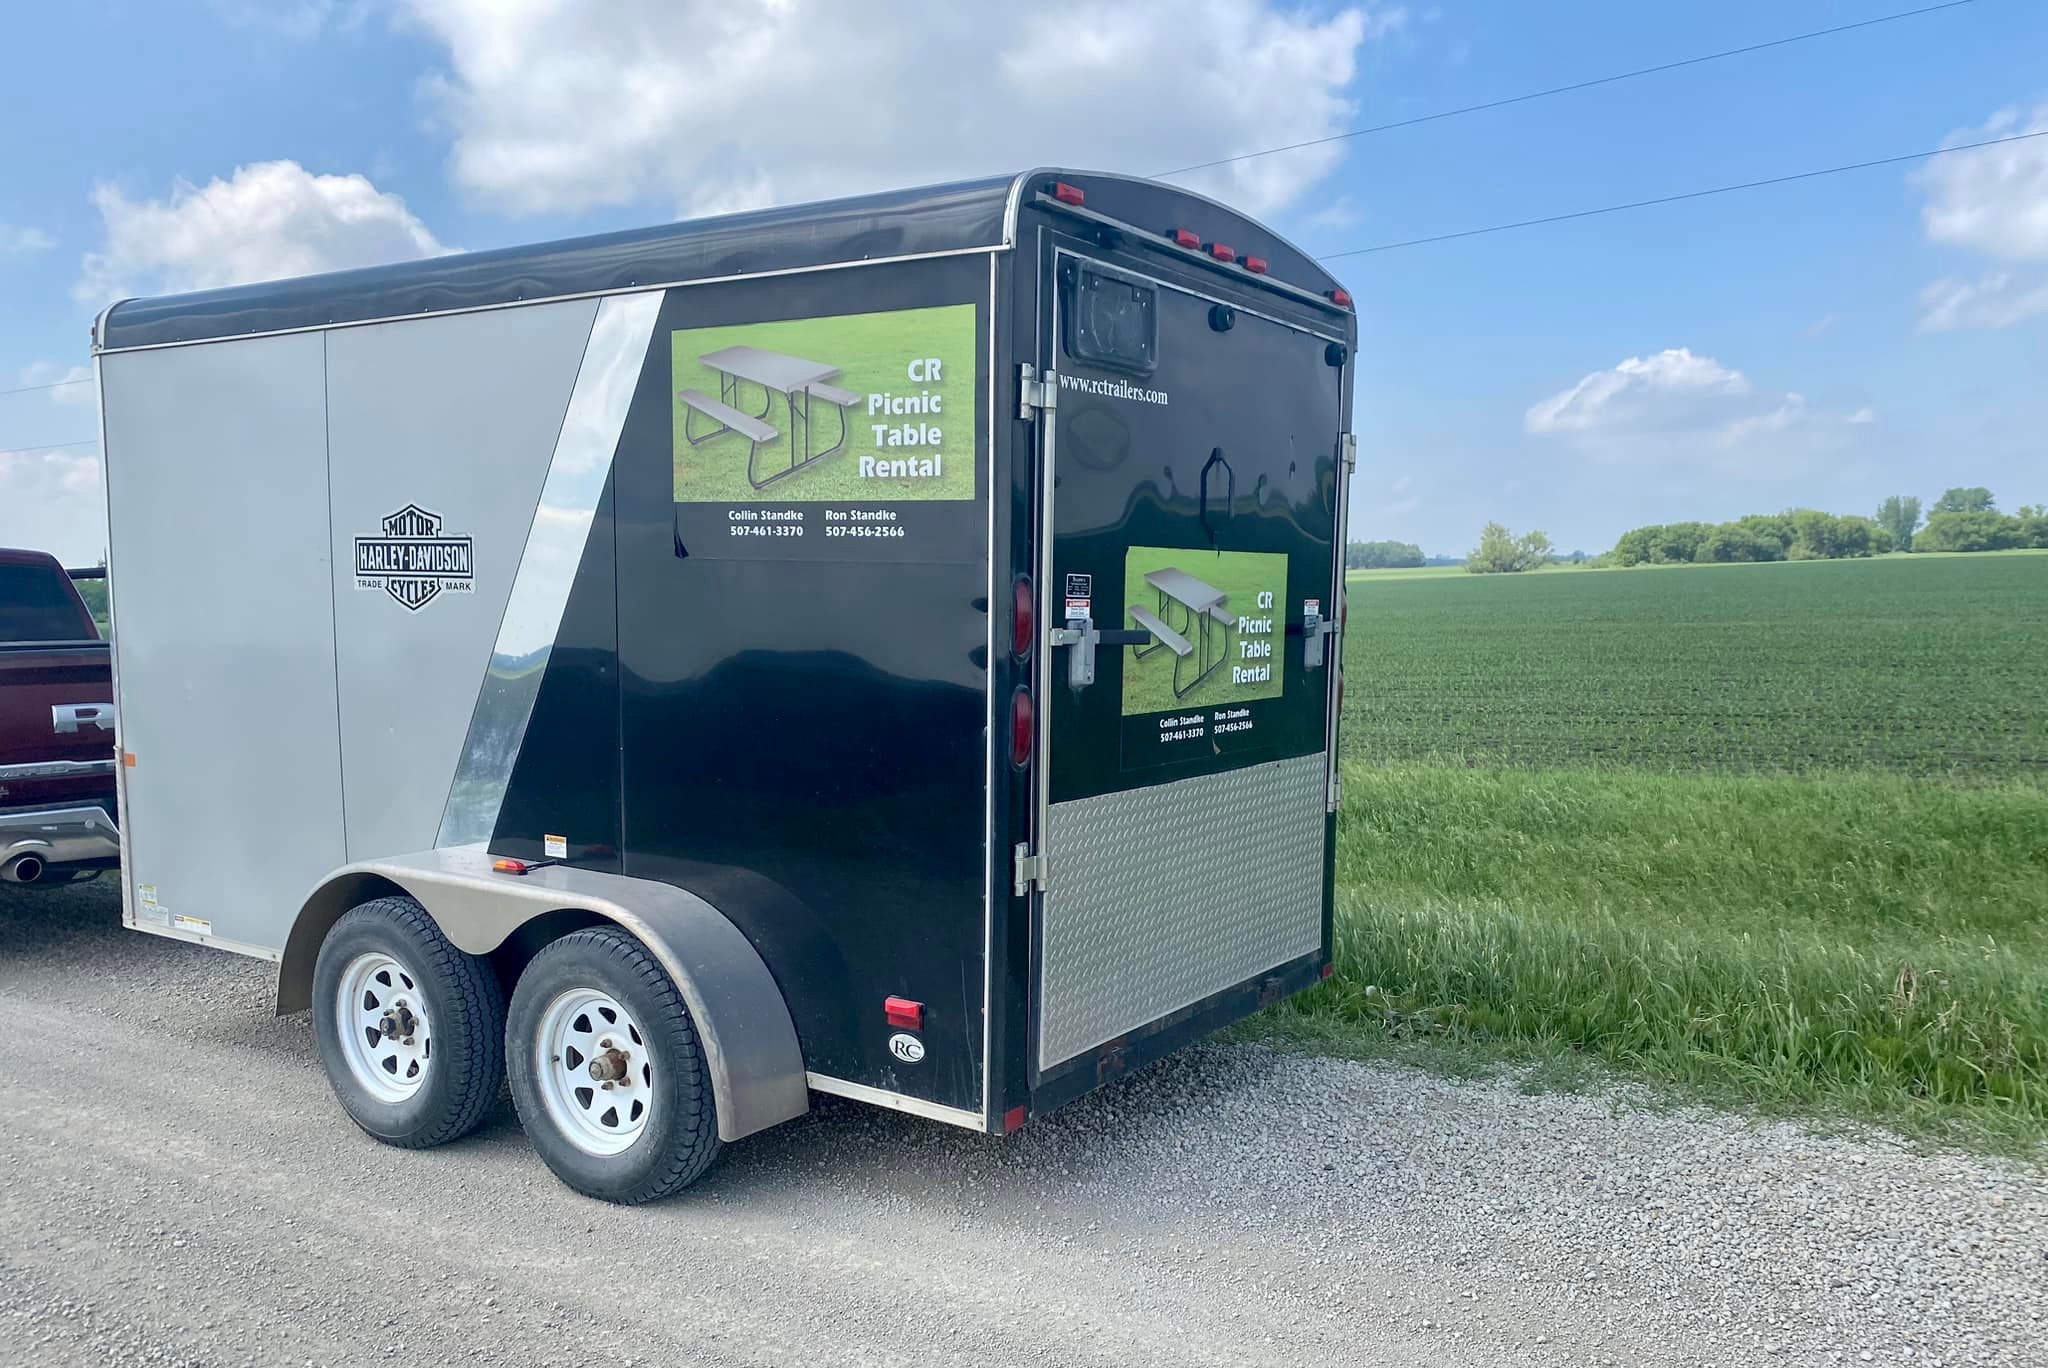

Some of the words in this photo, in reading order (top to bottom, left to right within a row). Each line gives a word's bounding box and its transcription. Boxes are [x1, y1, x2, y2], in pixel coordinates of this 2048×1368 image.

[907, 358, 942, 382] CR
[1059, 374, 1168, 405] www.rctrailers.com
[868, 390, 942, 416] Picnic
[871, 422, 942, 447] Table
[859, 454, 942, 478] Rental
[388, 509, 435, 536] MOTOR
[728, 510, 758, 521] Collin
[760, 510, 804, 521] Standke
[825, 510, 847, 521] Ron
[850, 509, 897, 521] Standke
[730, 526, 804, 536] 507-461-3370
[825, 526, 905, 537] 507-456-2566
[359, 544, 468, 572] HARLEY-DAVIDSON
[358, 579, 383, 589] TRADE
[445, 582, 472, 591] MARK
[391, 579, 436, 605] CYCLES
[1257, 591, 1273, 609] CR
[1238, 615, 1272, 634] Picnic
[1239, 640, 1272, 659] Table
[1232, 663, 1271, 684] Rental
[1160, 717, 1179, 729] Collin
[1179, 714, 1205, 726] Standke
[1214, 711, 1227, 721] Ron
[1227, 708, 1250, 719] Standke
[1160, 727, 1204, 743] 507-461-3370
[1214, 720, 1253, 734] 507-456-2566
[894, 1040, 921, 1059] RC
